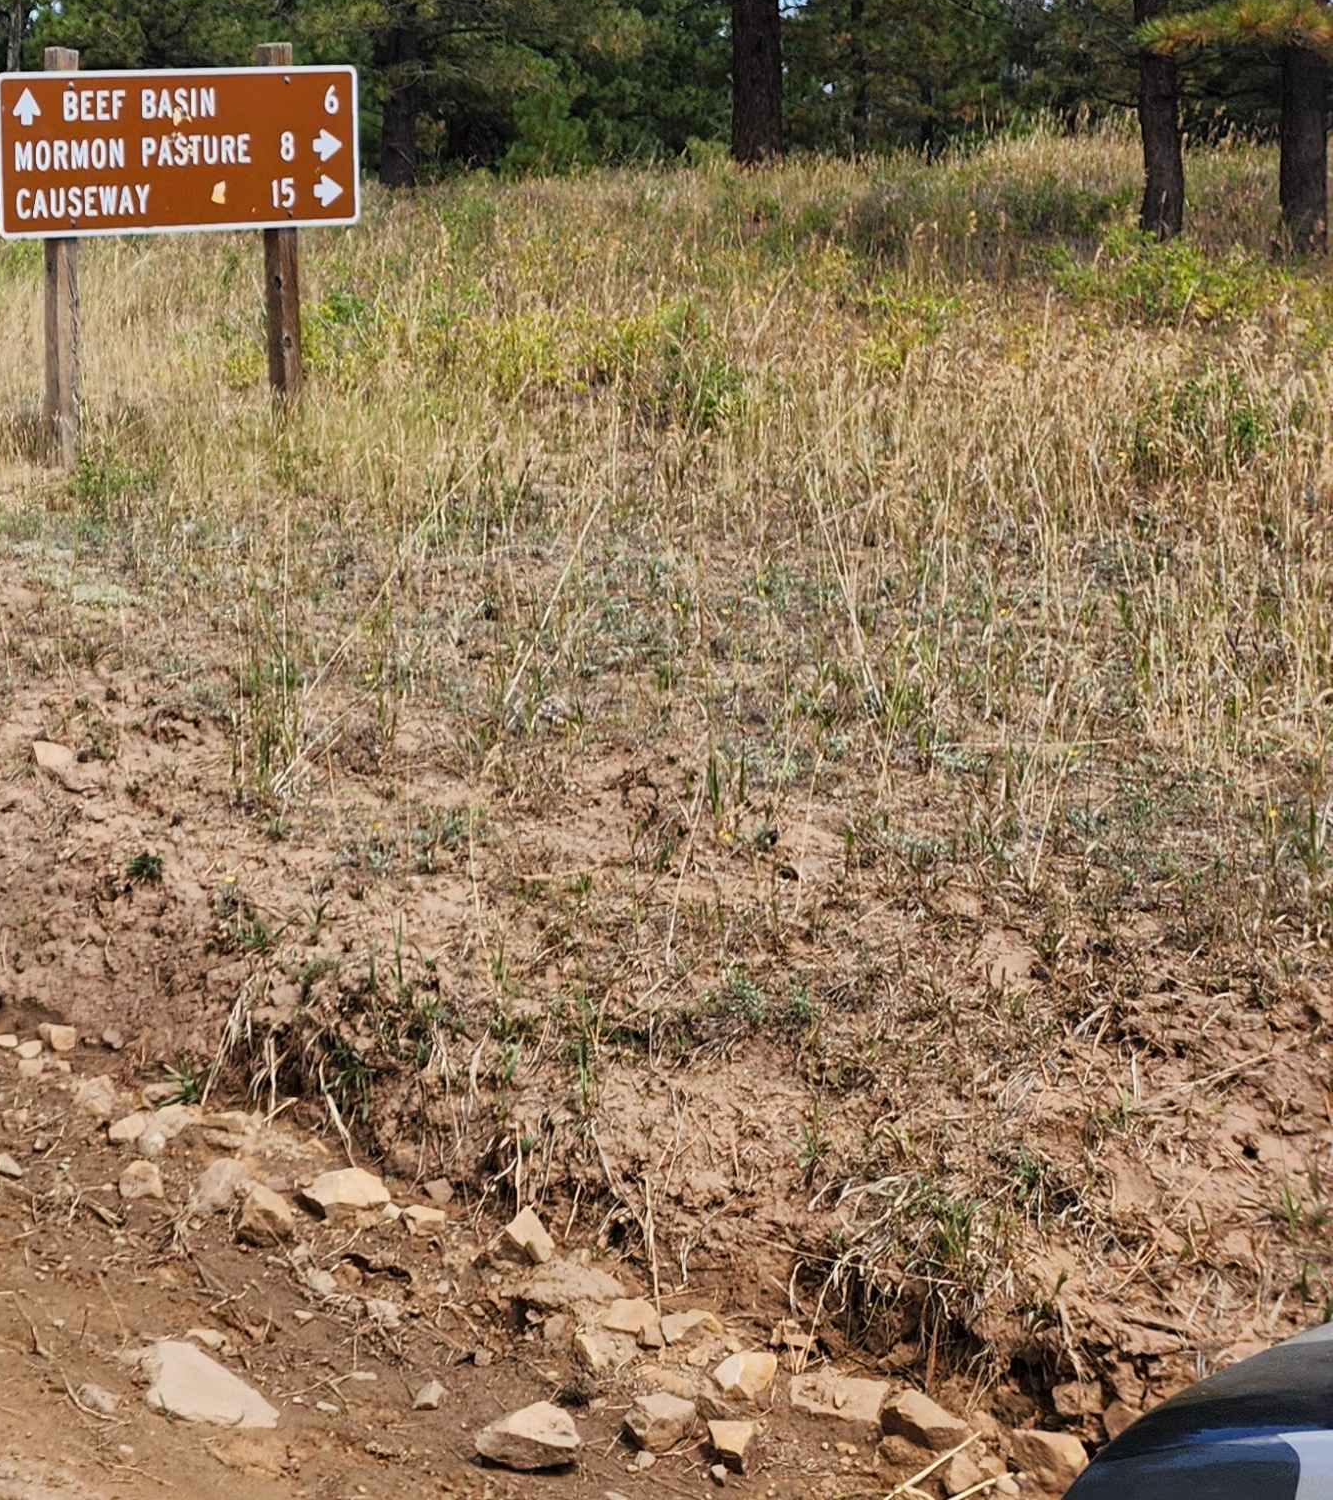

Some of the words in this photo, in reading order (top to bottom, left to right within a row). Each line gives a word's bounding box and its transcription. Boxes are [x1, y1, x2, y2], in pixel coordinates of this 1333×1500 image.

[62, 88, 126, 122] BEEF
[141, 87, 216, 120] BASIN
[324, 84, 339, 115] 6
[14, 137, 125, 172] MORMON
[141, 133, 252, 168] PASTURE
[280, 130, 295, 162] 8
[15, 184, 150, 219] CAUSEWAY
[271, 176, 296, 209] 15
